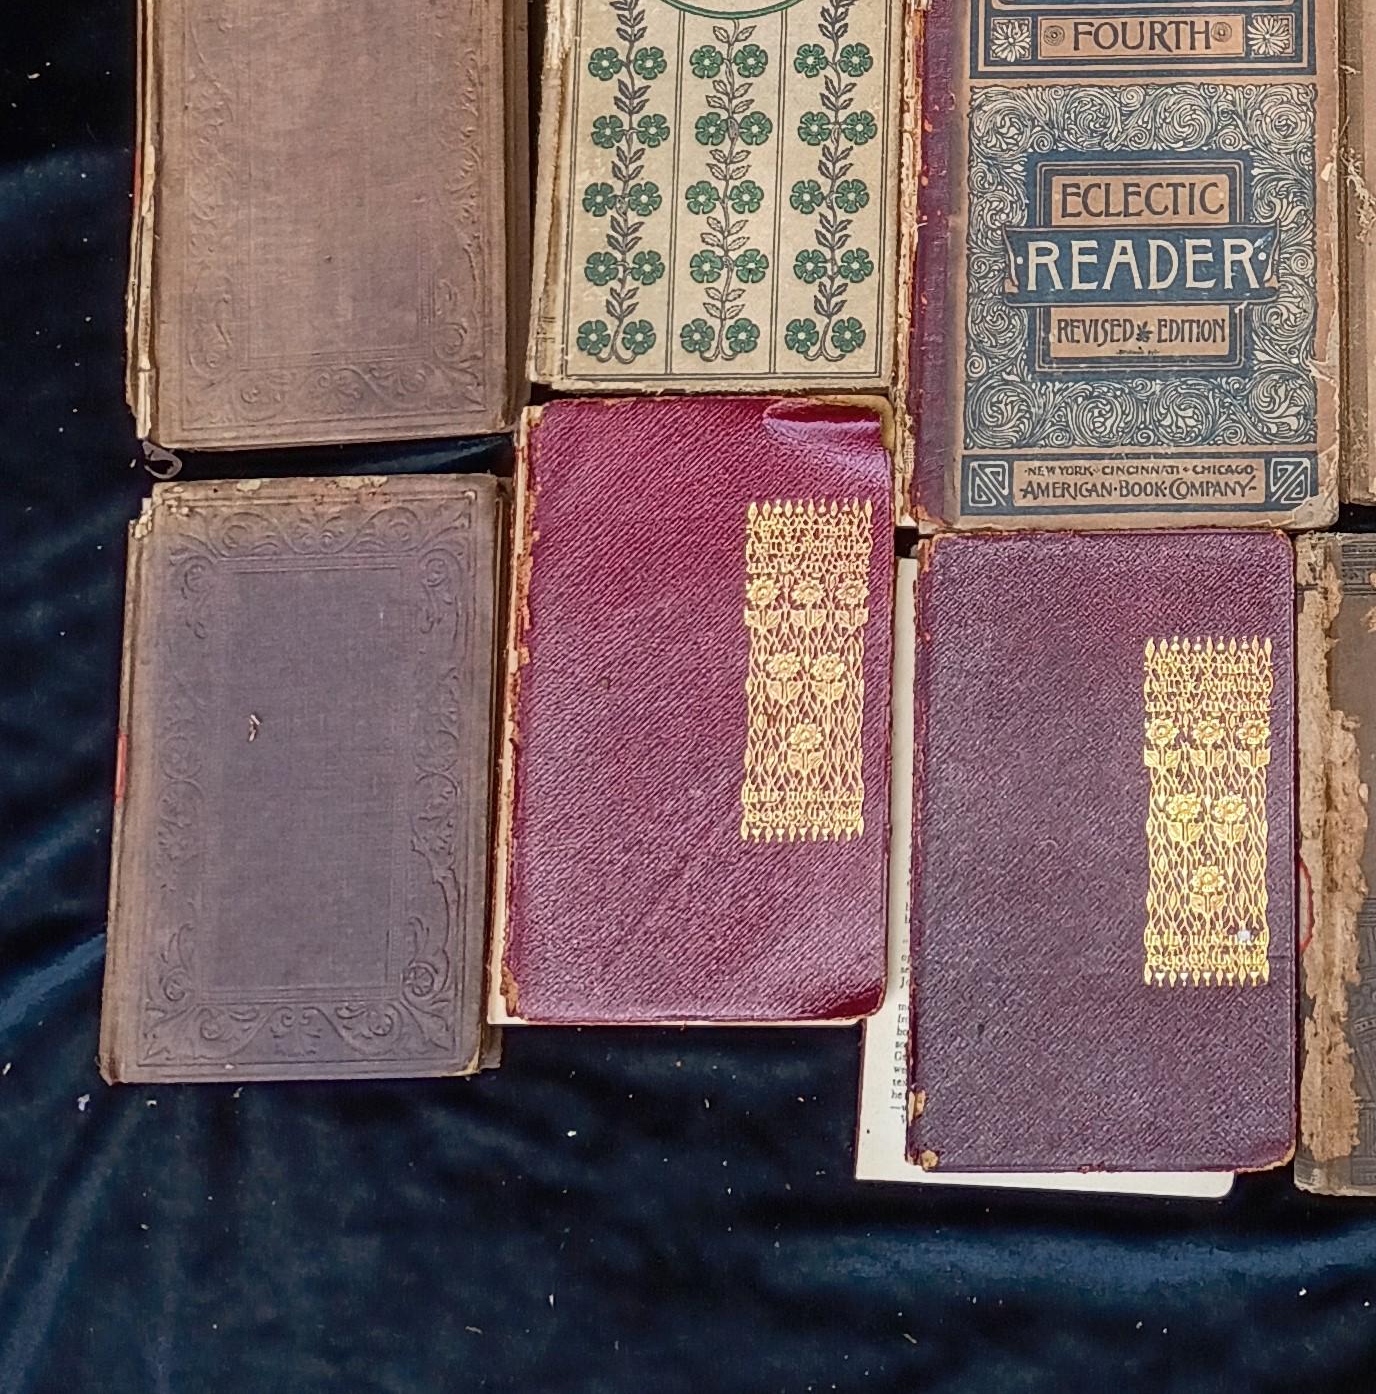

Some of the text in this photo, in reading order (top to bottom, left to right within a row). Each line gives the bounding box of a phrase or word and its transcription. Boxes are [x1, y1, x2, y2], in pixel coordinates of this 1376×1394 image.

[1073, 20, 1211, 52] FOURTH
[1060, 182, 1225, 218] ECLECTIC
[1056, 318, 1226, 347] REVISED EDITION
[1101, 464, 1180, 476] CINCINNATI
[1192, 464, 1255, 476] CHICAGO
